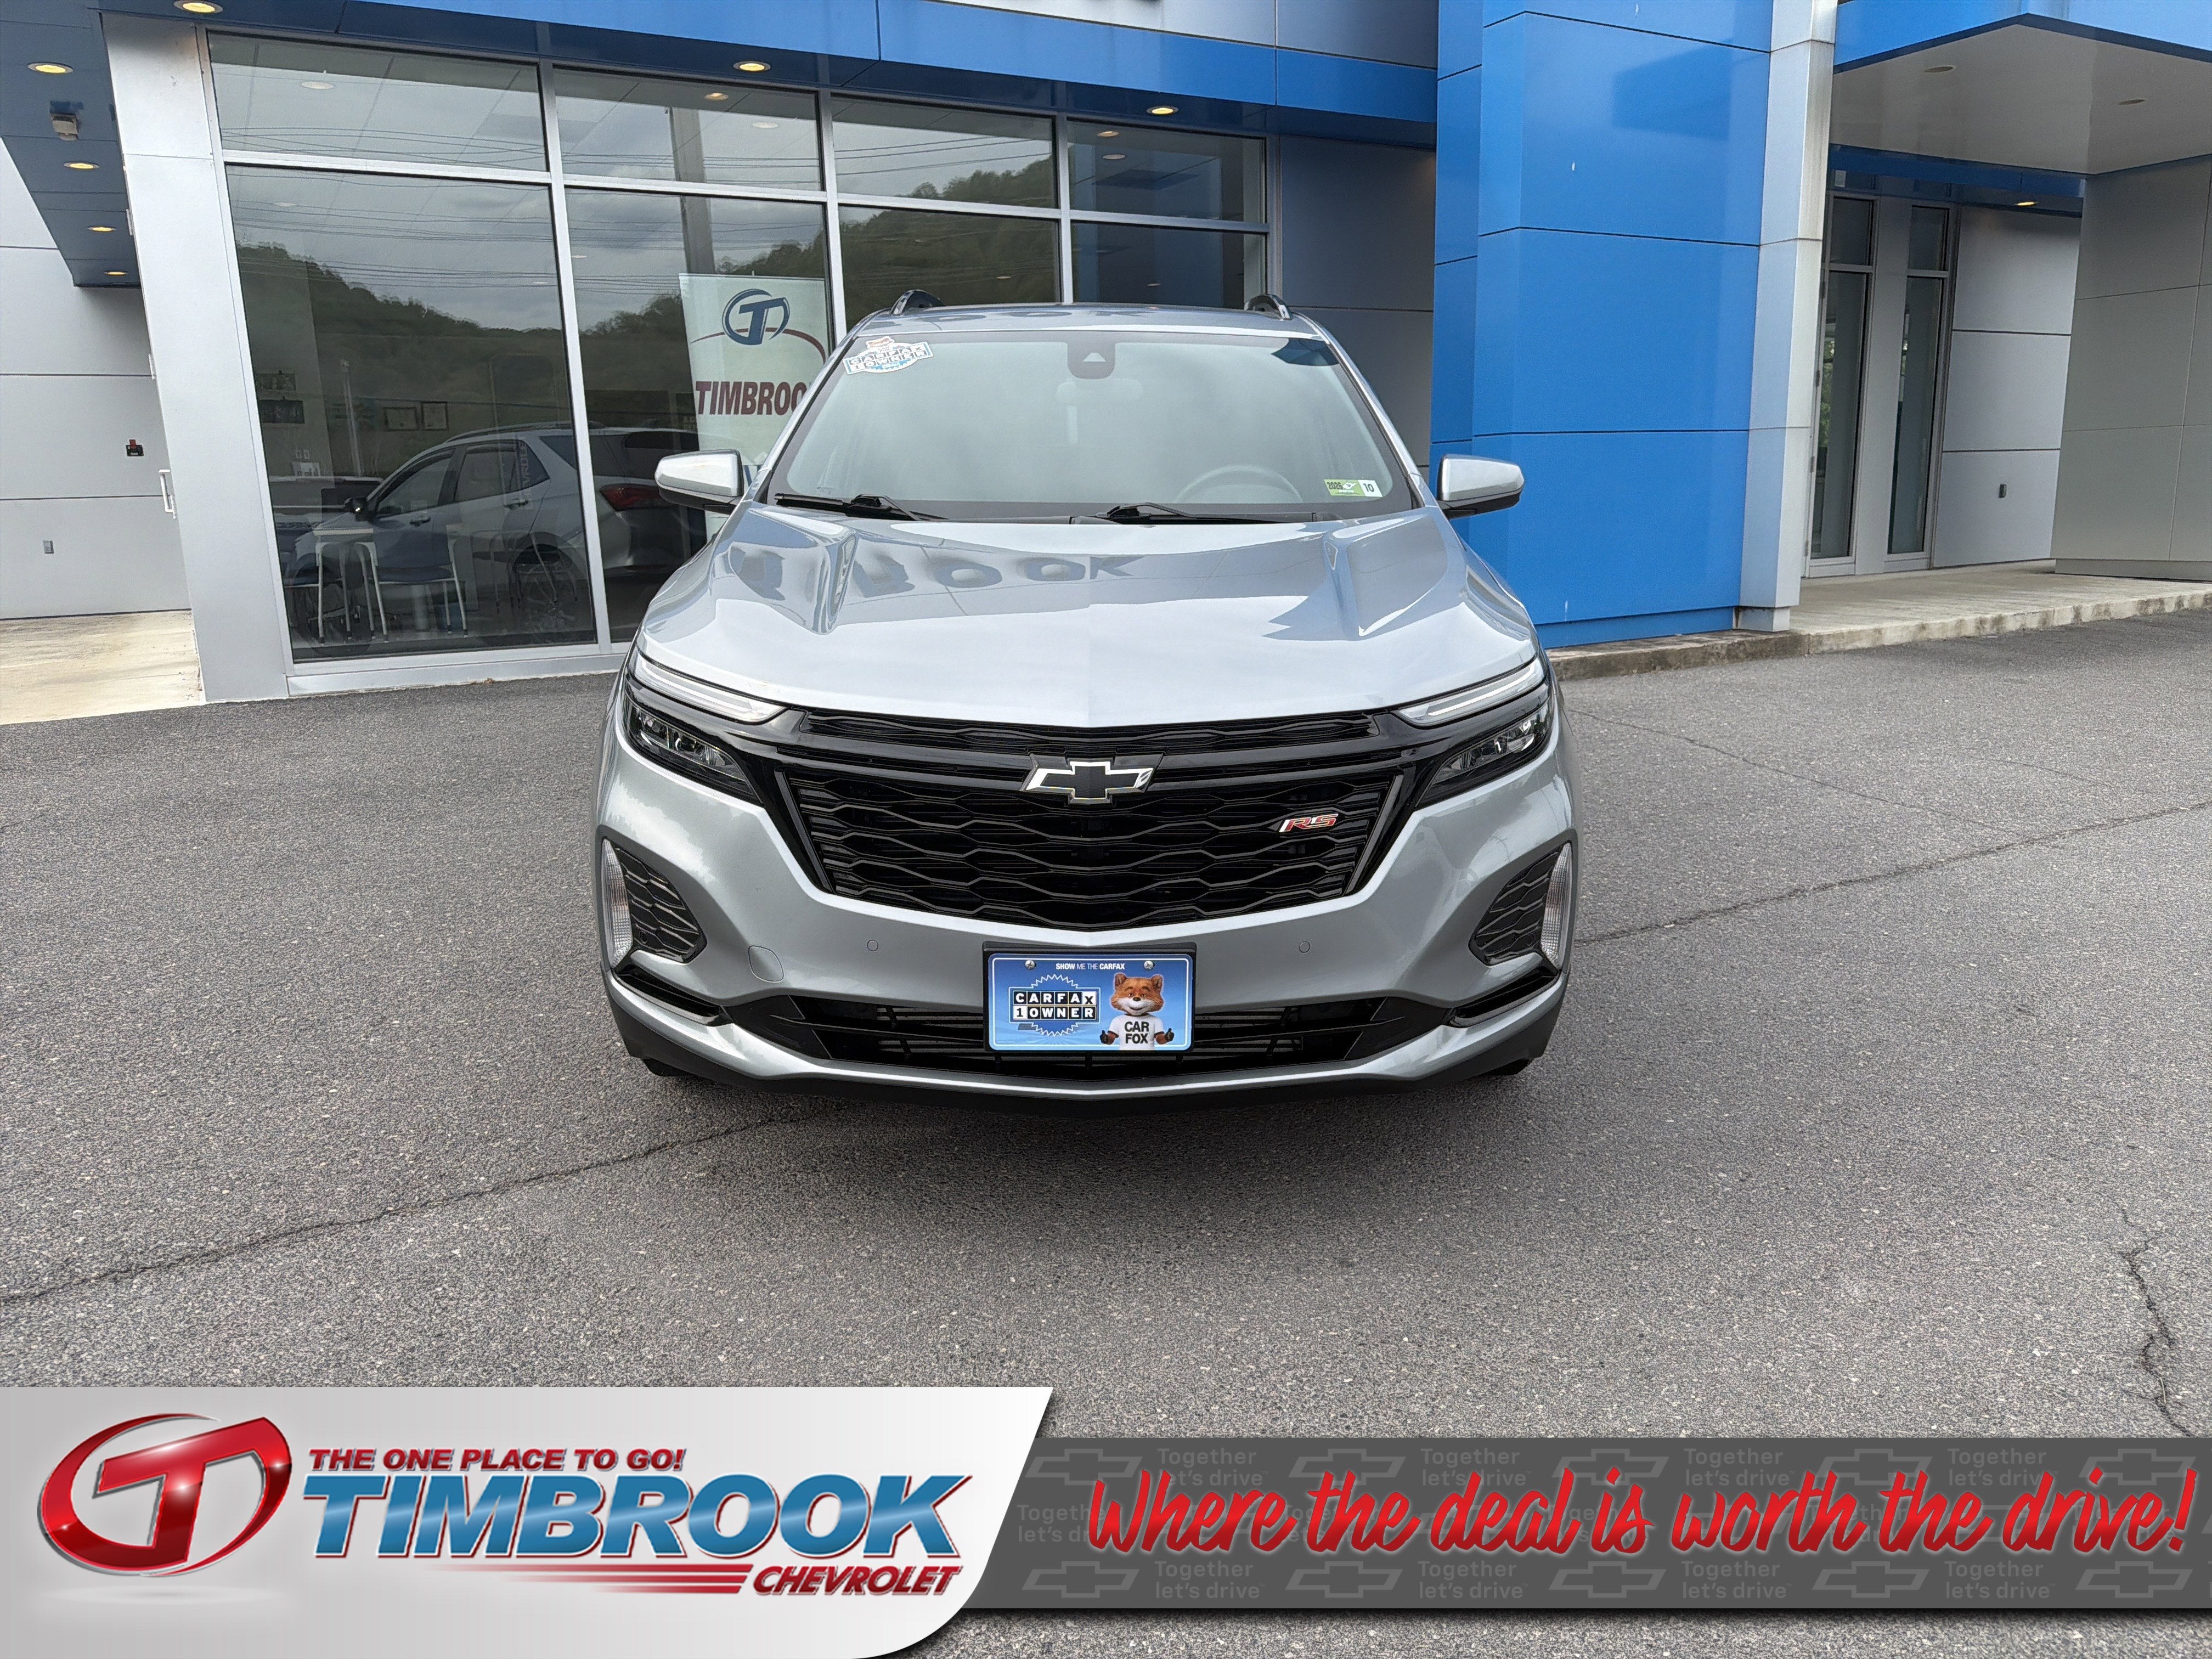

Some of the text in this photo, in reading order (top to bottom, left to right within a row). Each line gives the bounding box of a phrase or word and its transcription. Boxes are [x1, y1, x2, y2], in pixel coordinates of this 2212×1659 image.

[696, 381, 811, 415] TIMBROO
[1327, 481, 1344, 490] 2026
[1363, 483, 1375, 492] 10
[1279, 814, 1339, 833] RS
[1015, 992, 1095, 1005] CARFAX
[1125, 1021, 1149, 1032] CAR
[1125, 1034, 1149, 1044] FOX
